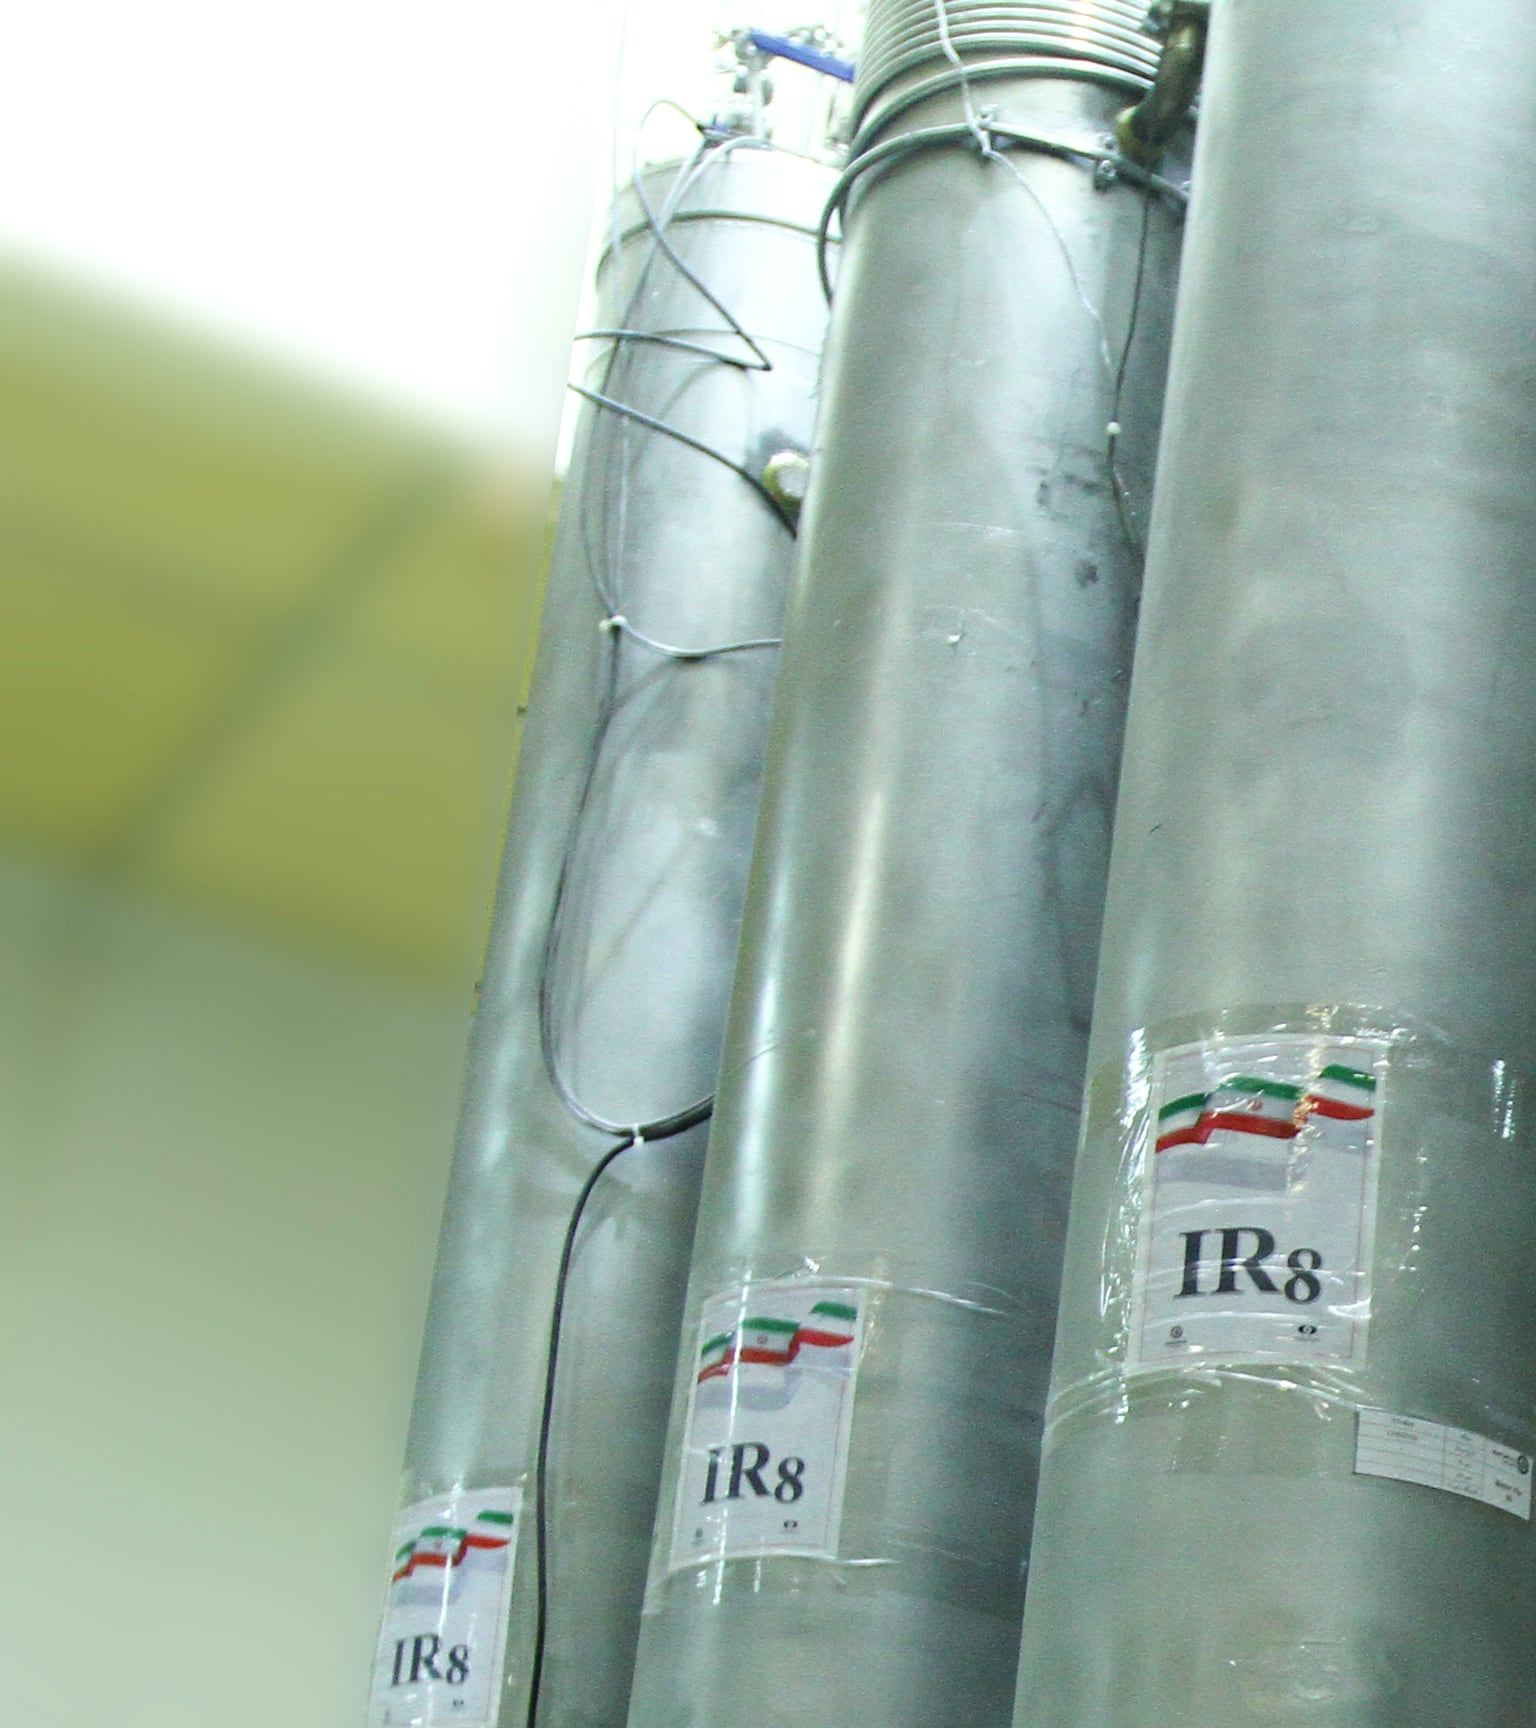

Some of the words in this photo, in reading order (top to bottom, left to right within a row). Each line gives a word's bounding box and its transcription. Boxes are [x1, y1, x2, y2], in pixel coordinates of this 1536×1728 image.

[1174, 1227, 1324, 1305] IR8
[700, 1441, 806, 1507] IR8
[390, 1633, 470, 1687] IR8
